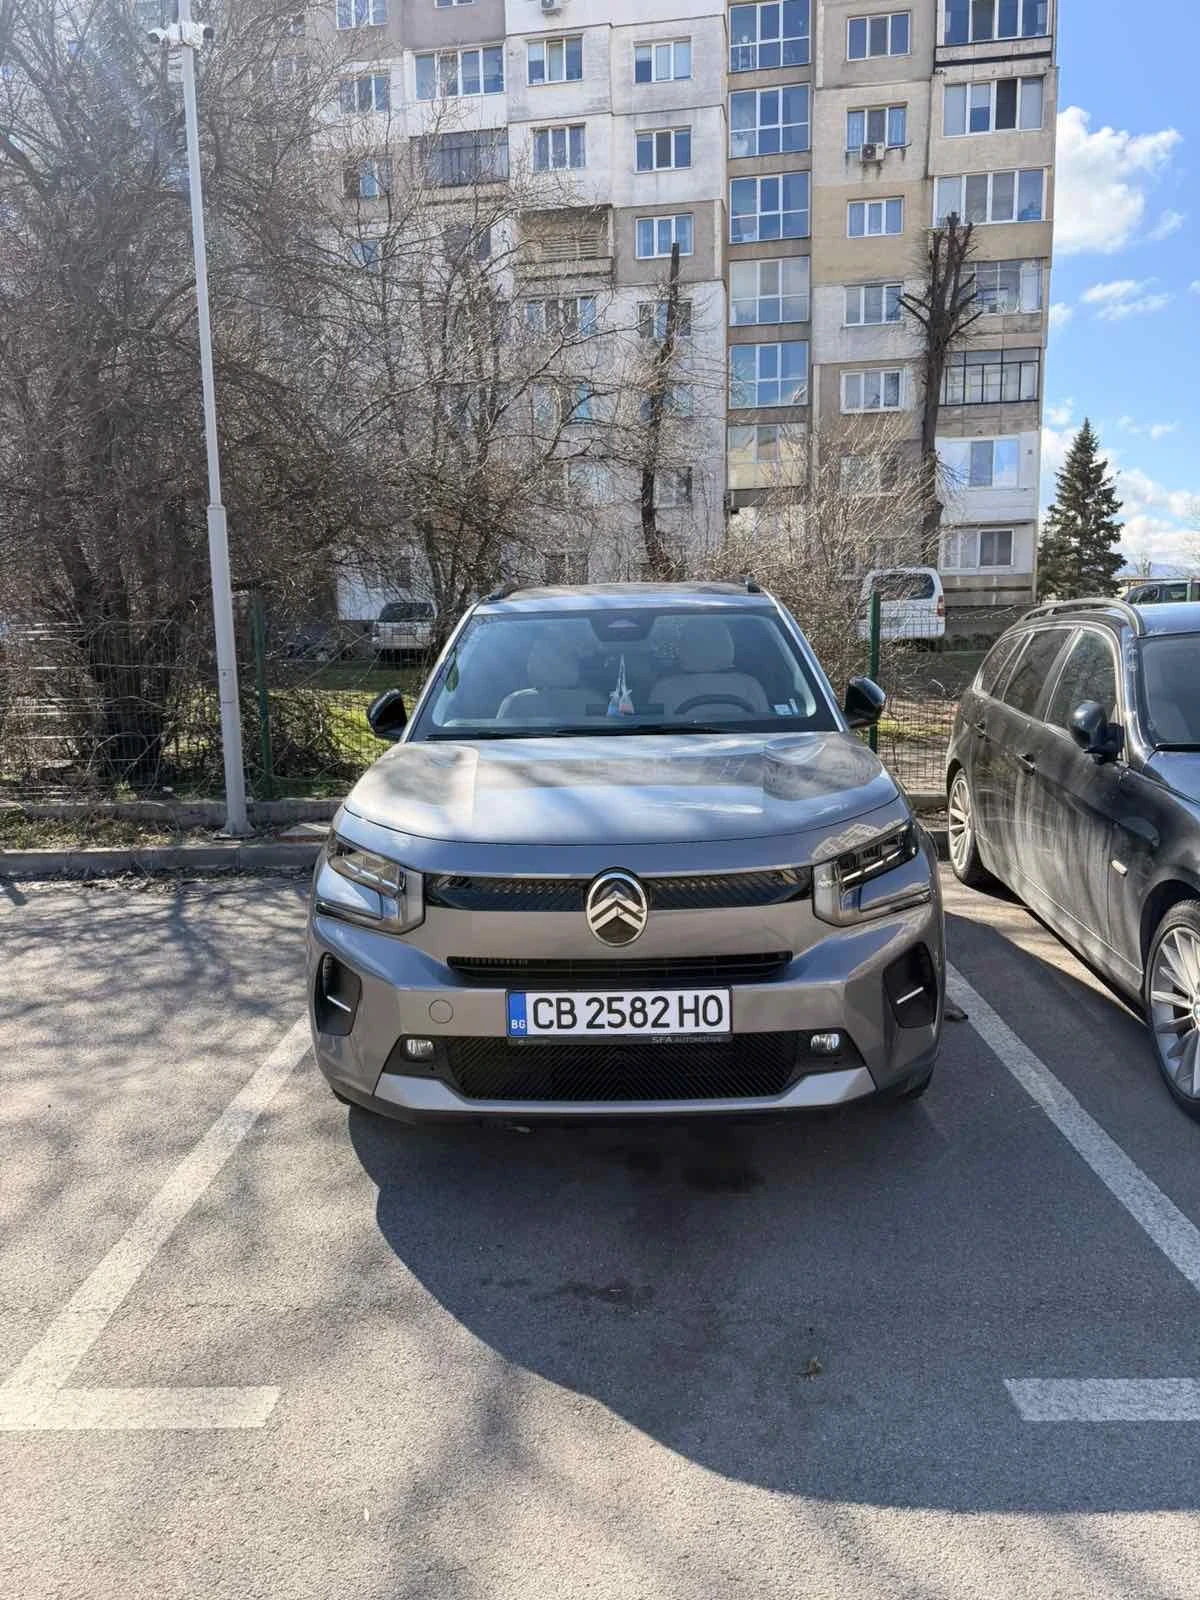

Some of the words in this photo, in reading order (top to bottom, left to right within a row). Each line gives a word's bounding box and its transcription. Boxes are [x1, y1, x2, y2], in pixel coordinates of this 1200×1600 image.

[533, 997, 578, 1030] CB
[585, 996, 670, 1029] 2582
[678, 994, 723, 1027] HO
[511, 1019, 526, 1029] BG
